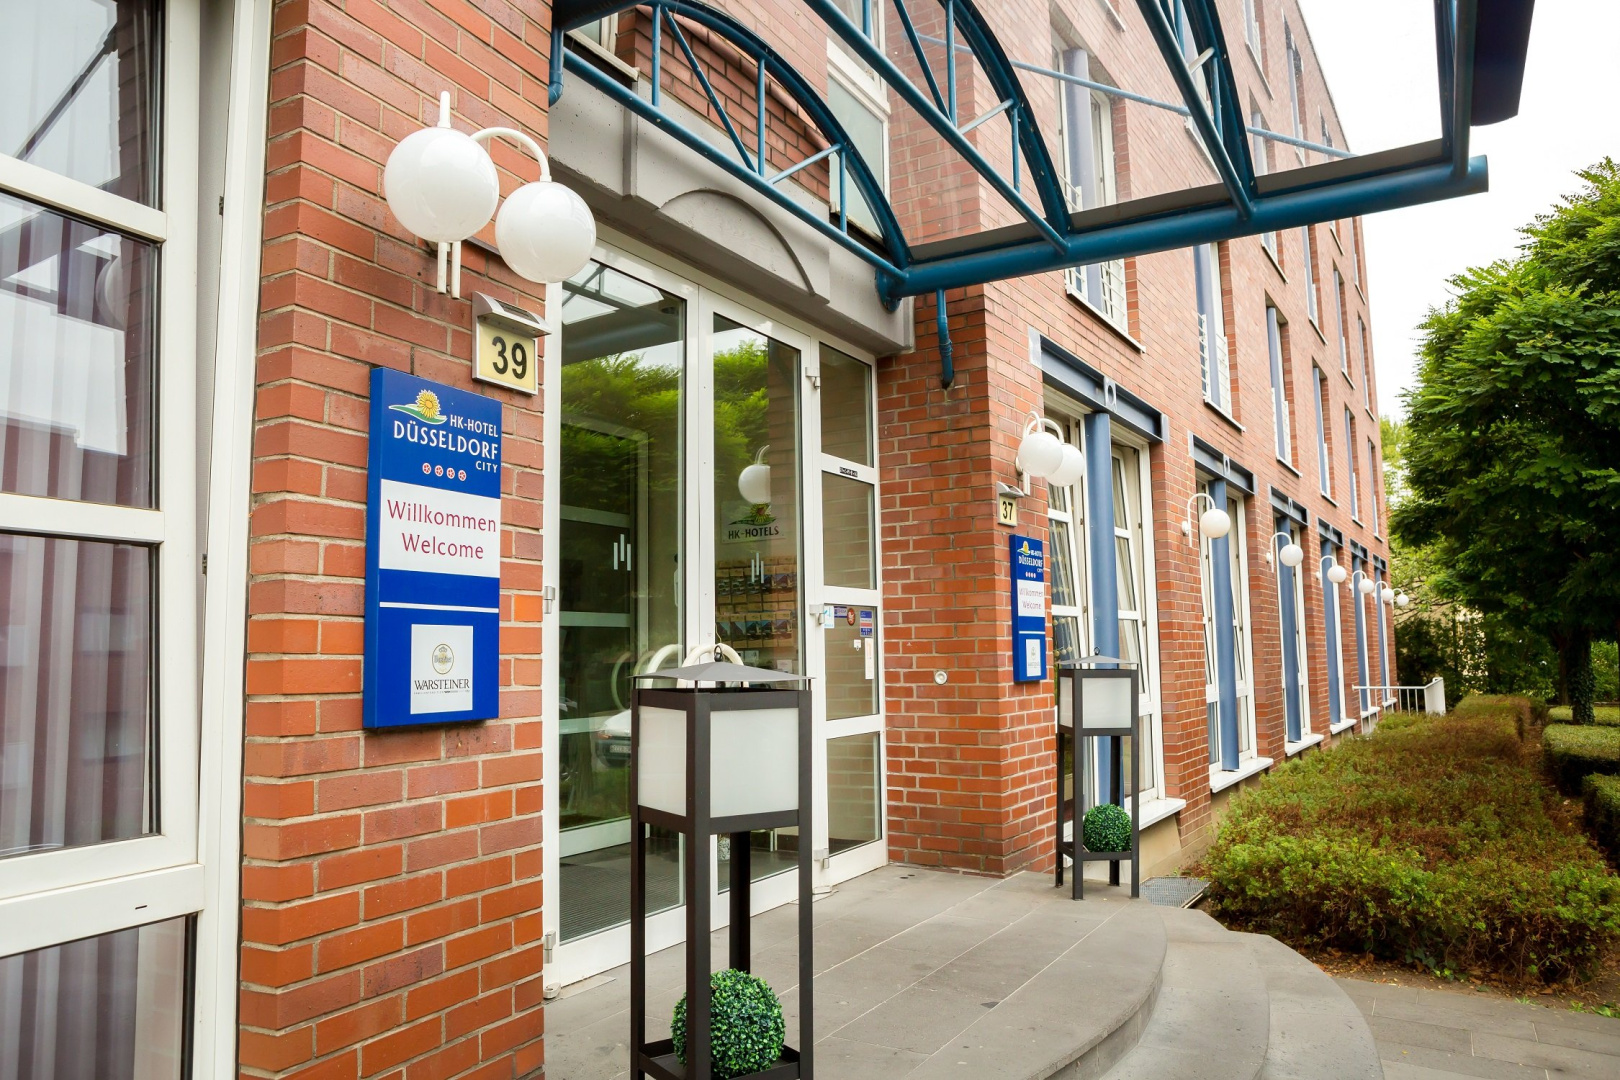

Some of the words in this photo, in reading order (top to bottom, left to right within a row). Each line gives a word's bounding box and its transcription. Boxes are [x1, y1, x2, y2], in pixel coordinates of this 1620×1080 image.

[492, 336, 527, 380] 39
[450, 414, 498, 438] HK-HOTEL
[393, 420, 498, 460] DÜSSELDORF
[475, 461, 498, 473] CITY
[387, 499, 496, 533] Willkommen
[1002, 501, 1014, 521] 37
[728, 526, 780, 539] HK-HOTELS
[402, 532, 484, 560] Welcome
[1018, 555, 1043, 567] DÜSSELDORF
[1022, 600, 1042, 610] Welcome
[414, 678, 470, 690] WARSTEINER
